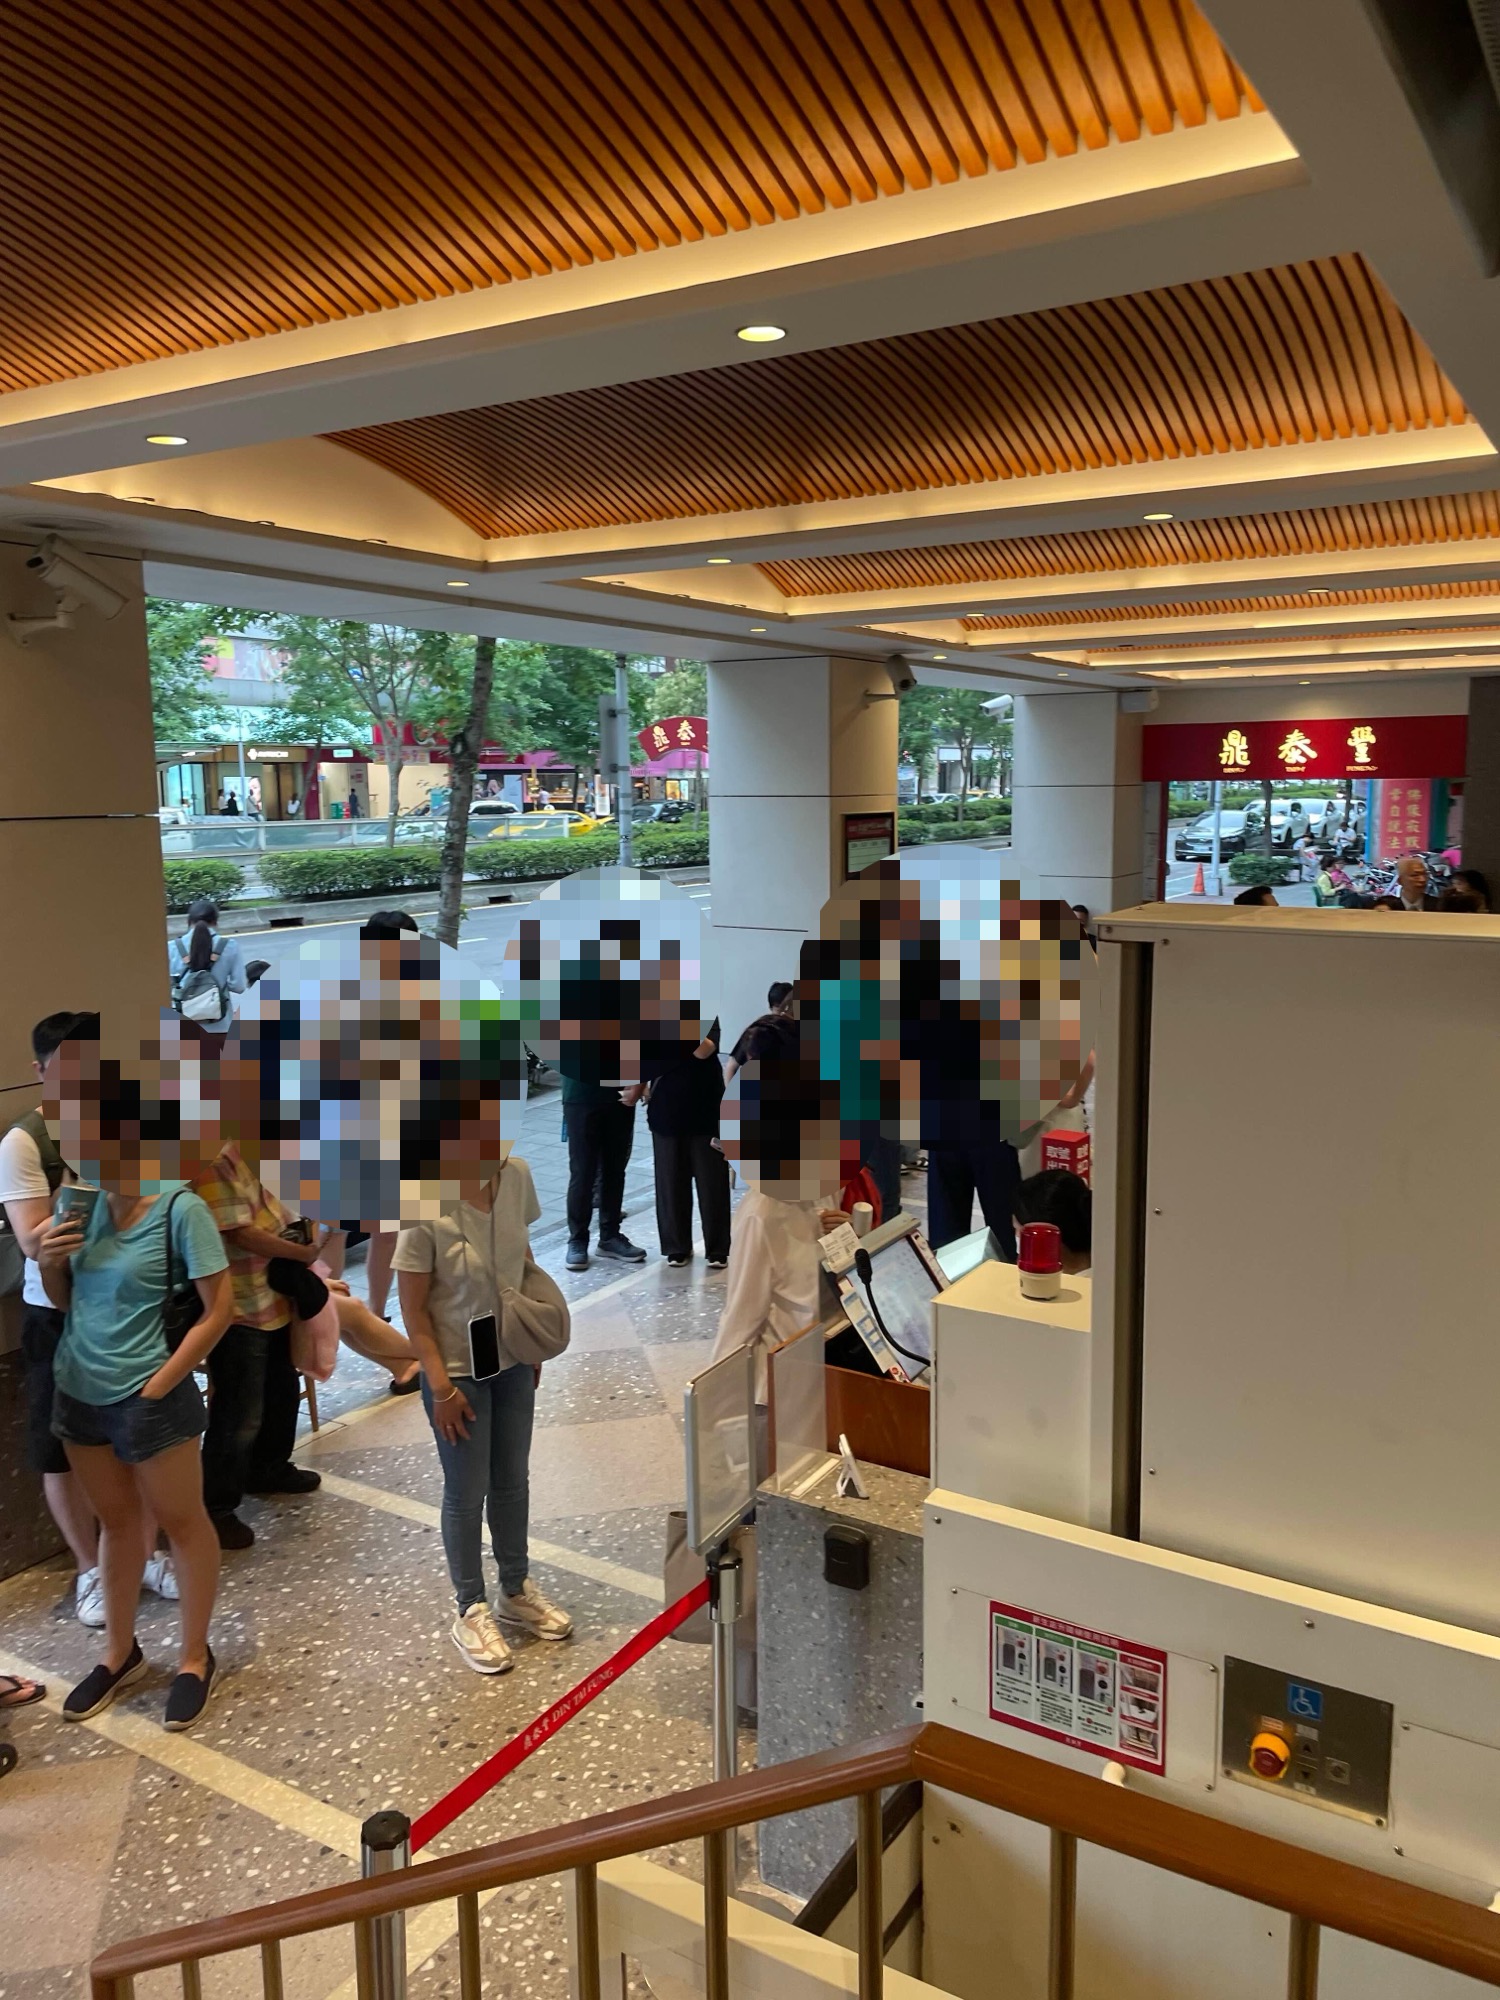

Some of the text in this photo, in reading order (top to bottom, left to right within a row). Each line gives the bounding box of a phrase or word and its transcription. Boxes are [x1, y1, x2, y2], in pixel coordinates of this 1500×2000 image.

[1219, 726, 1377, 765] 鼎泰豐
[552, 1700, 572, 1722] DIN
[573, 1687, 588, 1706] TAI
[587, 1667, 614, 1692] FUNG
